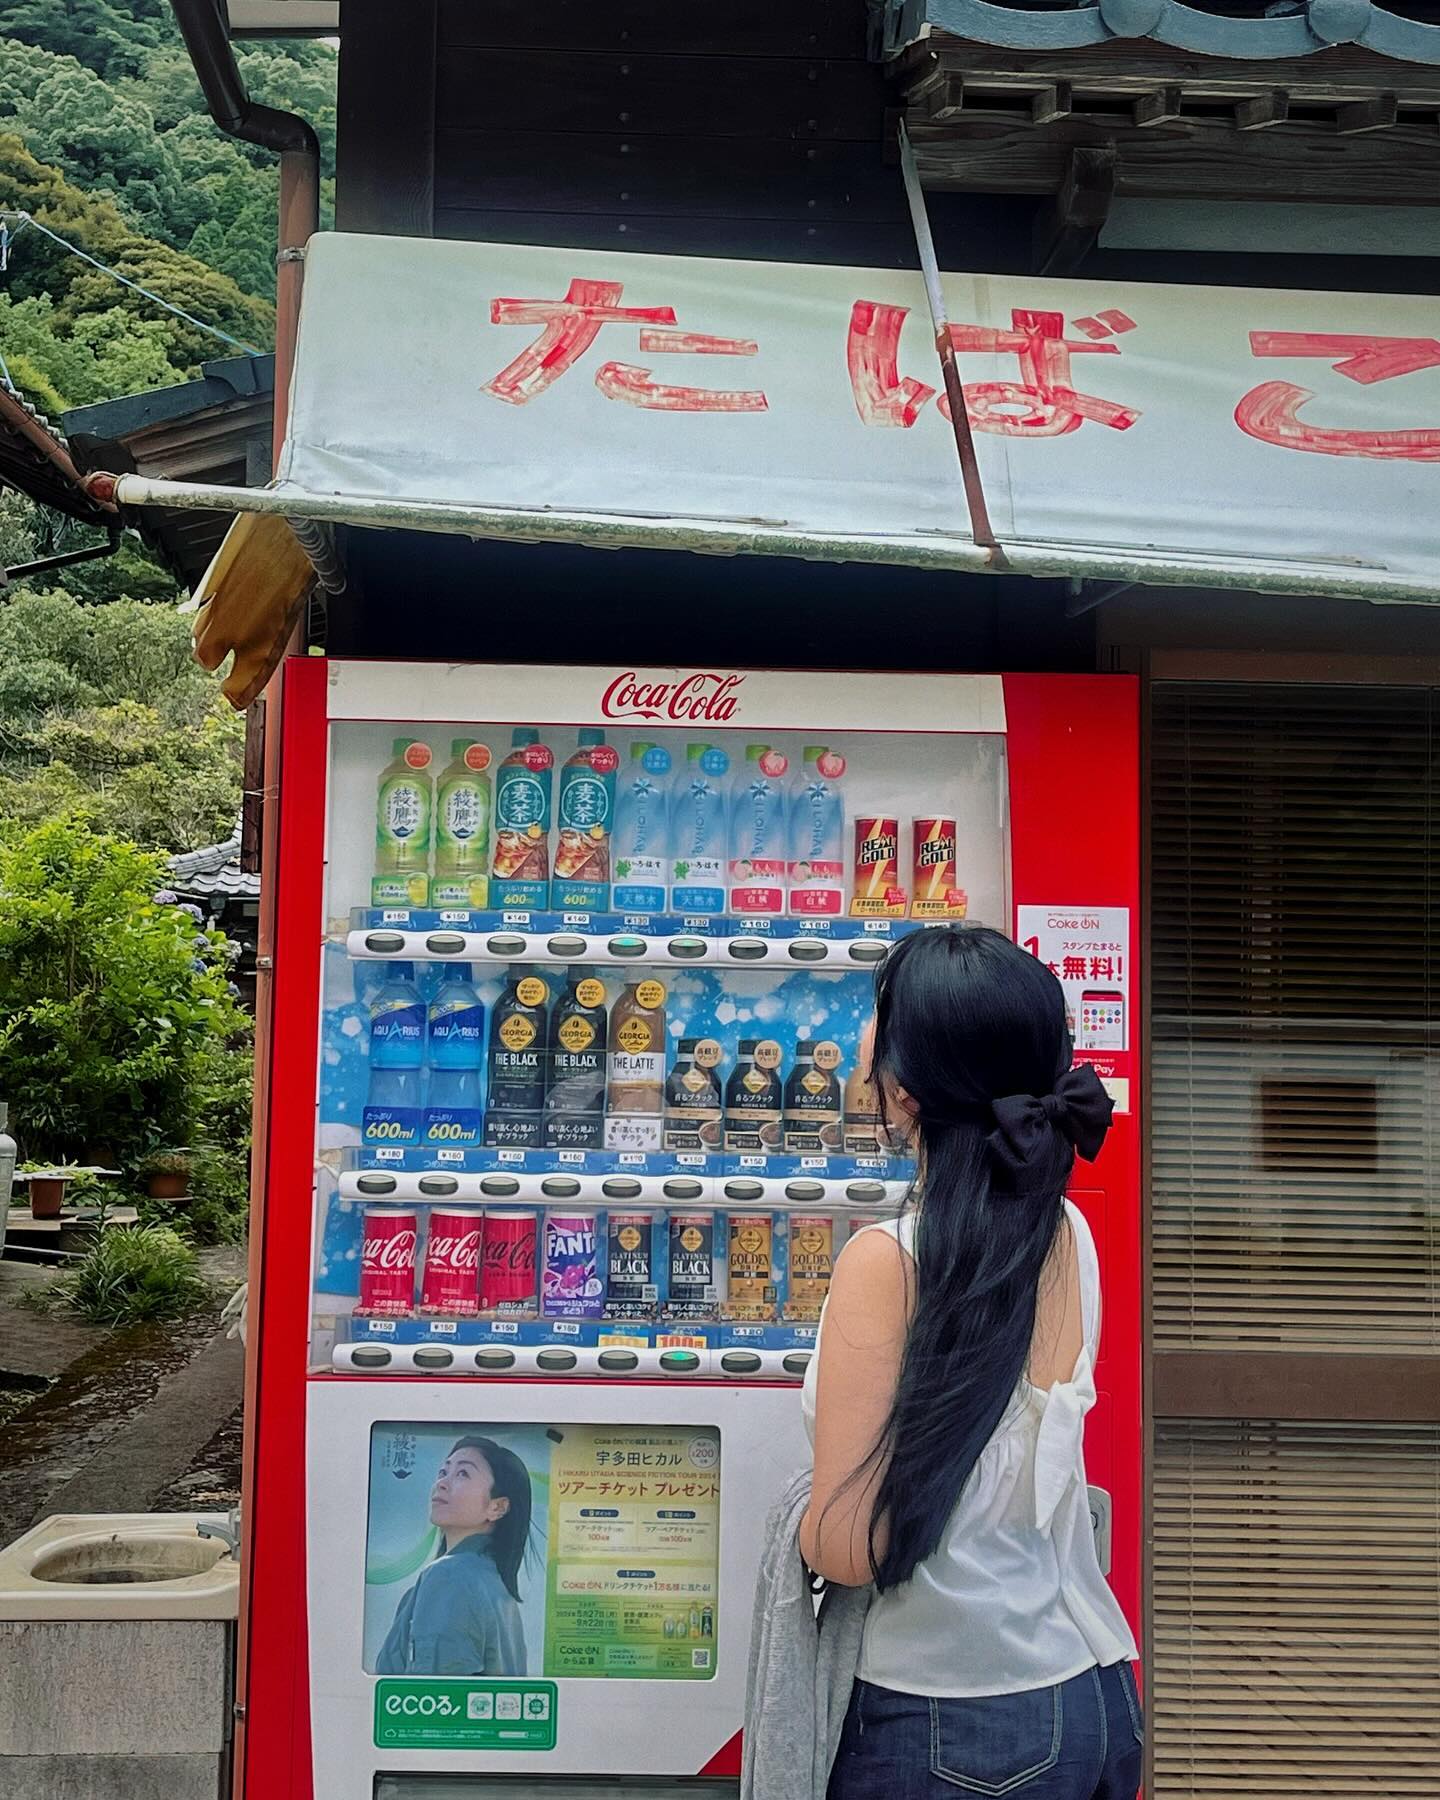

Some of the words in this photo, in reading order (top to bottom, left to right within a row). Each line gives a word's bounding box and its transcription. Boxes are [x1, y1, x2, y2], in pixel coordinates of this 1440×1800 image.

[479, 278, 1440, 462] たばこ
[601, 671, 748, 721] Coca-Cola
[391, 787, 412, 826] 綾鷹
[452, 789, 473, 827] 綾鷹
[511, 782, 532, 822] 麦茶
[574, 783, 595, 823] 麦茶
[862, 833, 896, 854] REAL
[921, 834, 955, 855] REAL
[861, 847, 895, 865] GOLD
[921, 849, 954, 867] GOLD
[1047, 918, 1079, 929] Coke
[1080, 916, 1100, 929] ON
[1062, 942, 1123, 952] スタンプたまると
[373, 1021, 420, 1041] AQUARIUS
[433, 1022, 480, 1041] AQUARIUS
[501, 1029, 533, 1037] GEORGIA
[561, 1030, 593, 1038] GEORGIA
[618, 1032, 650, 1040] GEORGIA
[495, 1053, 509, 1065] THE
[510, 1053, 538, 1066] BLACK
[555, 1054, 569, 1067] THE
[569, 1055, 597, 1067] BLACK
[613, 1057, 628, 1069] THE
[629, 1057, 655, 1070] LATTE
[1093, 1063, 1115, 1076] Pay
[365, 1122, 414, 1140] 600ml
[428, 1123, 476, 1140] 600ml
[548, 1232, 596, 1257] FANT
[611, 1260, 649, 1274] BLACK
[672, 1261, 710, 1274] BLACK
[730, 1253, 769, 1266] GOLDEN
[793, 1254, 831, 1266] GOLDEN
[596, 1450, 683, 1466] 宇多田ヒカル
[558, 1481, 648, 1496] ツアーチケット
[655, 1482, 720, 1497] プレゼント
[561, 1580, 586, 1590] Coke
[559, 1645, 583, 1655] Coke
